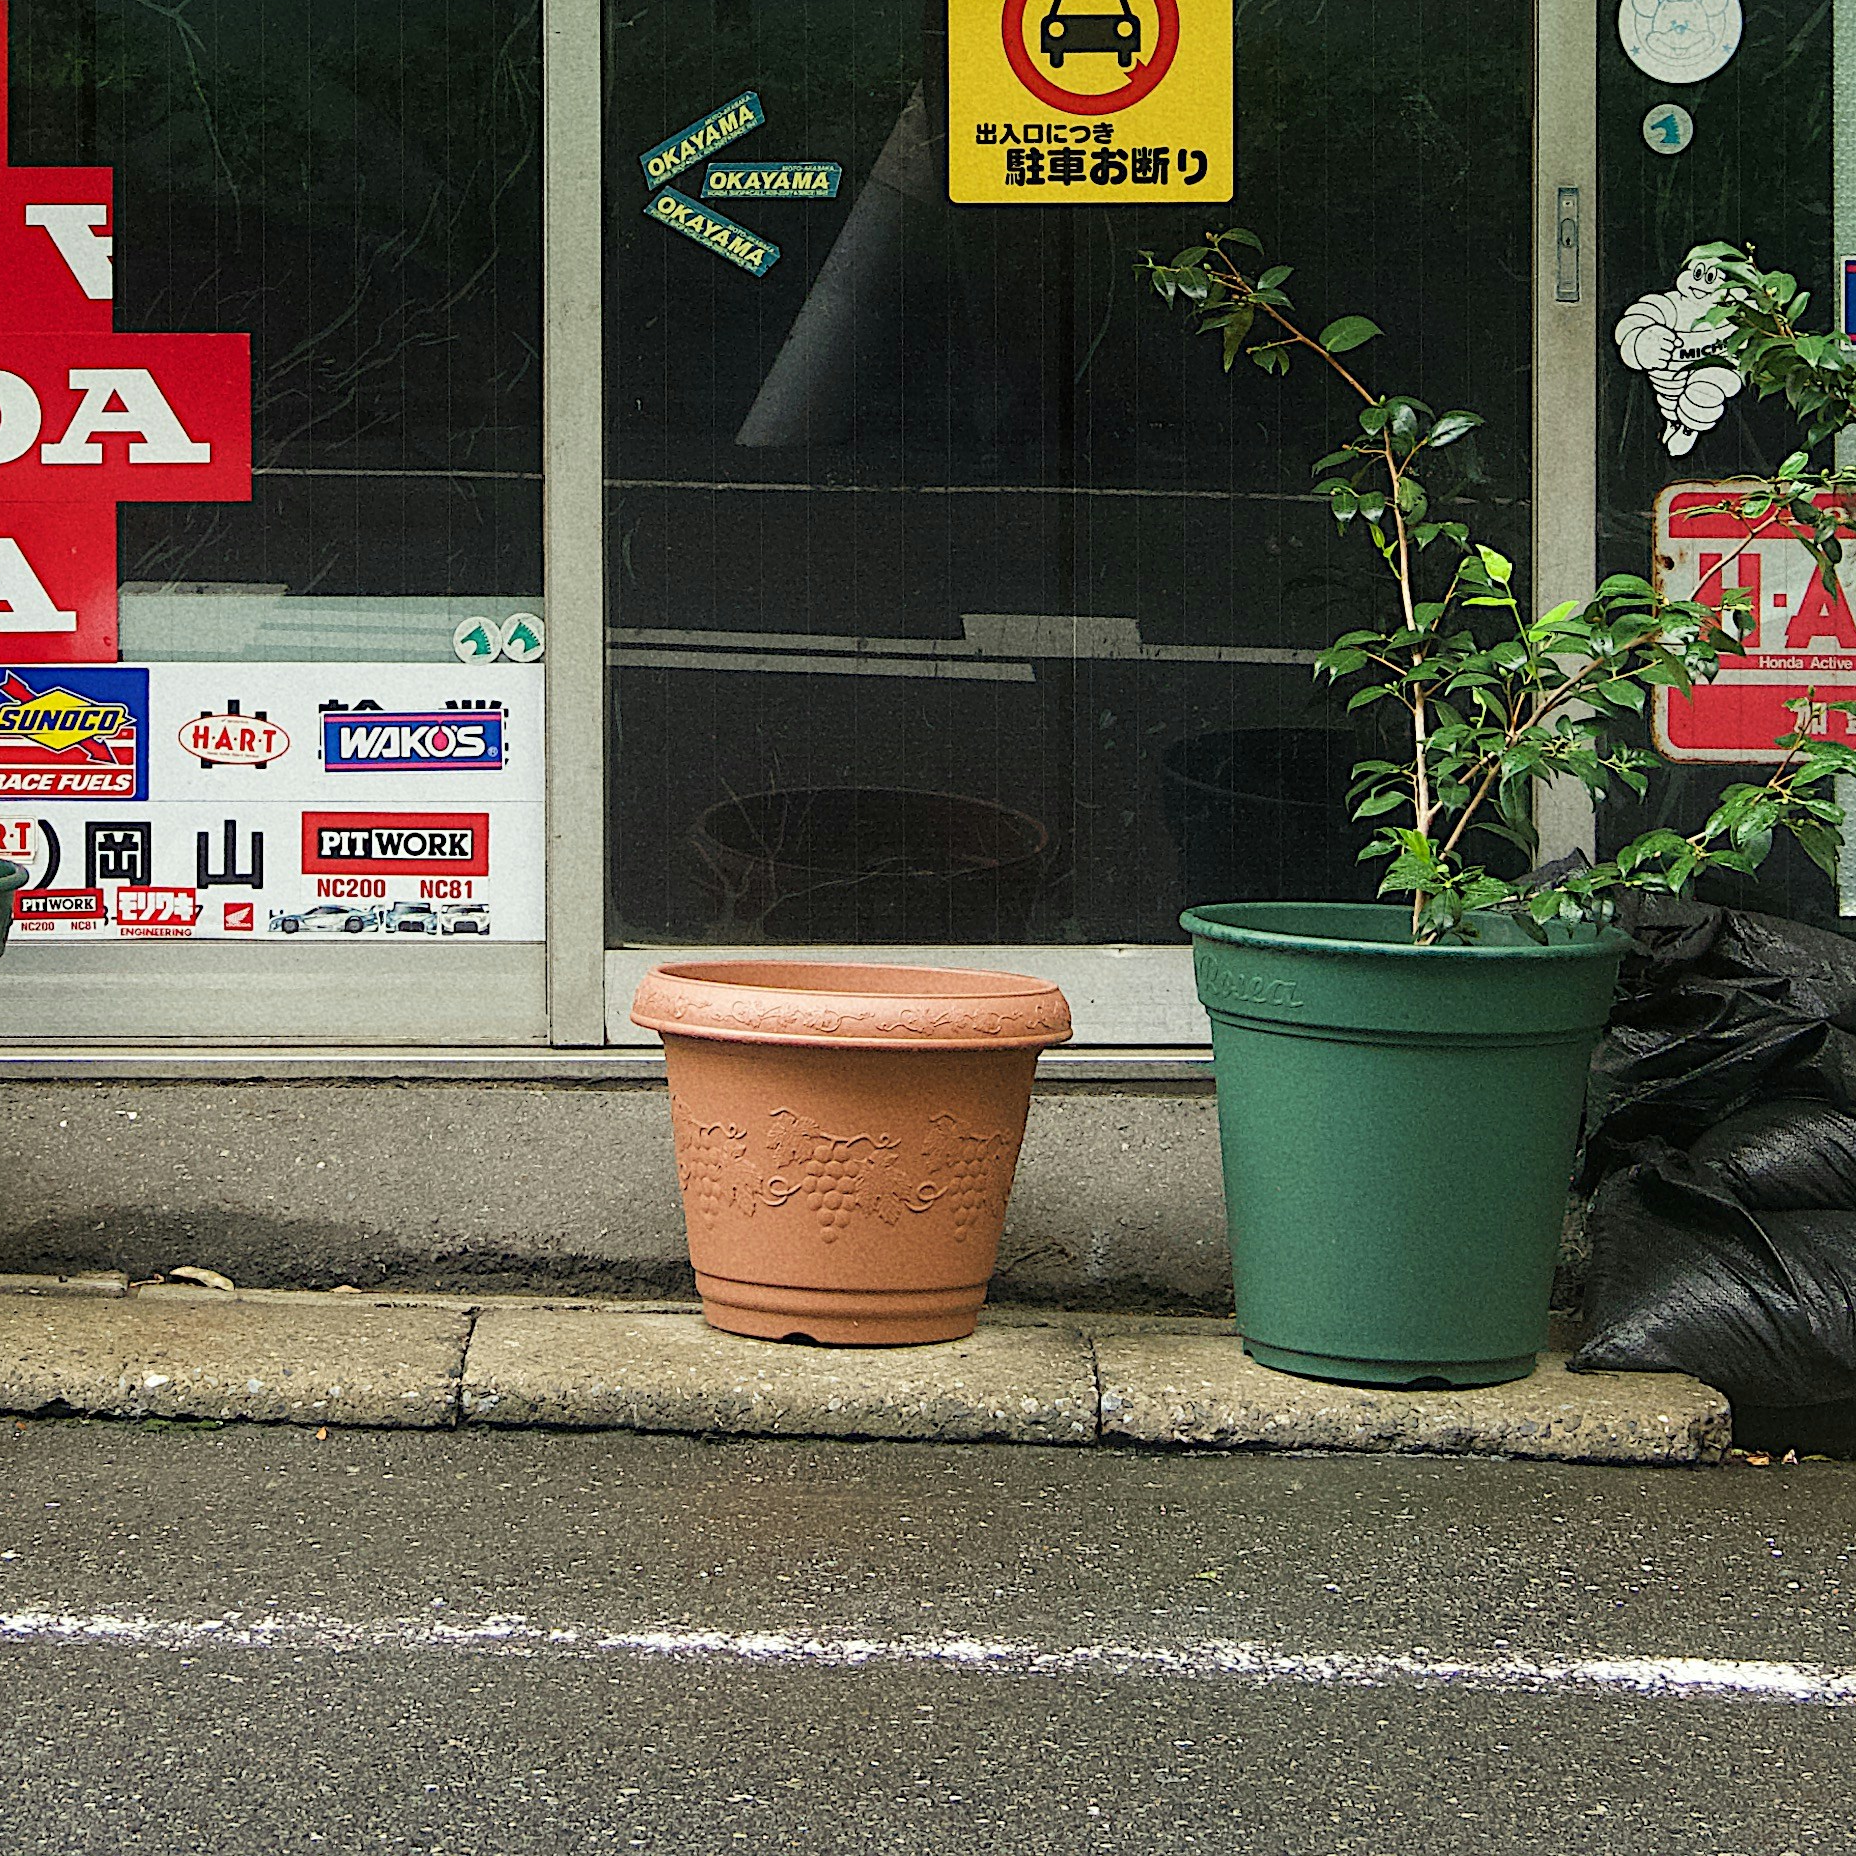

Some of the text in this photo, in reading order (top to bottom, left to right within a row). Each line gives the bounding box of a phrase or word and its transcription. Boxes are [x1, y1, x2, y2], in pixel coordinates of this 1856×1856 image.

[647, 105, 754, 177] OKAYAMA
[975, 122, 1115, 145] 出入口につき
[1005, 146, 1208, 186] 駐車お断り
[709, 171, 830, 190] OKAYAMA
[657, 196, 765, 268] OKAYAMA
[1679, 343, 1728, 360] MICH
[1759, 655, 1804, 669] Honda
[1810, 656, 1854, 670] Active
[339, 724, 487, 759] WAKO'S
[56, 773, 133, 791] FUELS
[317, 878, 473, 899] NC200 NC81
[118, 891, 194, 921] モリワキ
[21, 920, 97, 932] NC200 NC81
[120, 927, 192, 937] ENGINEERING
